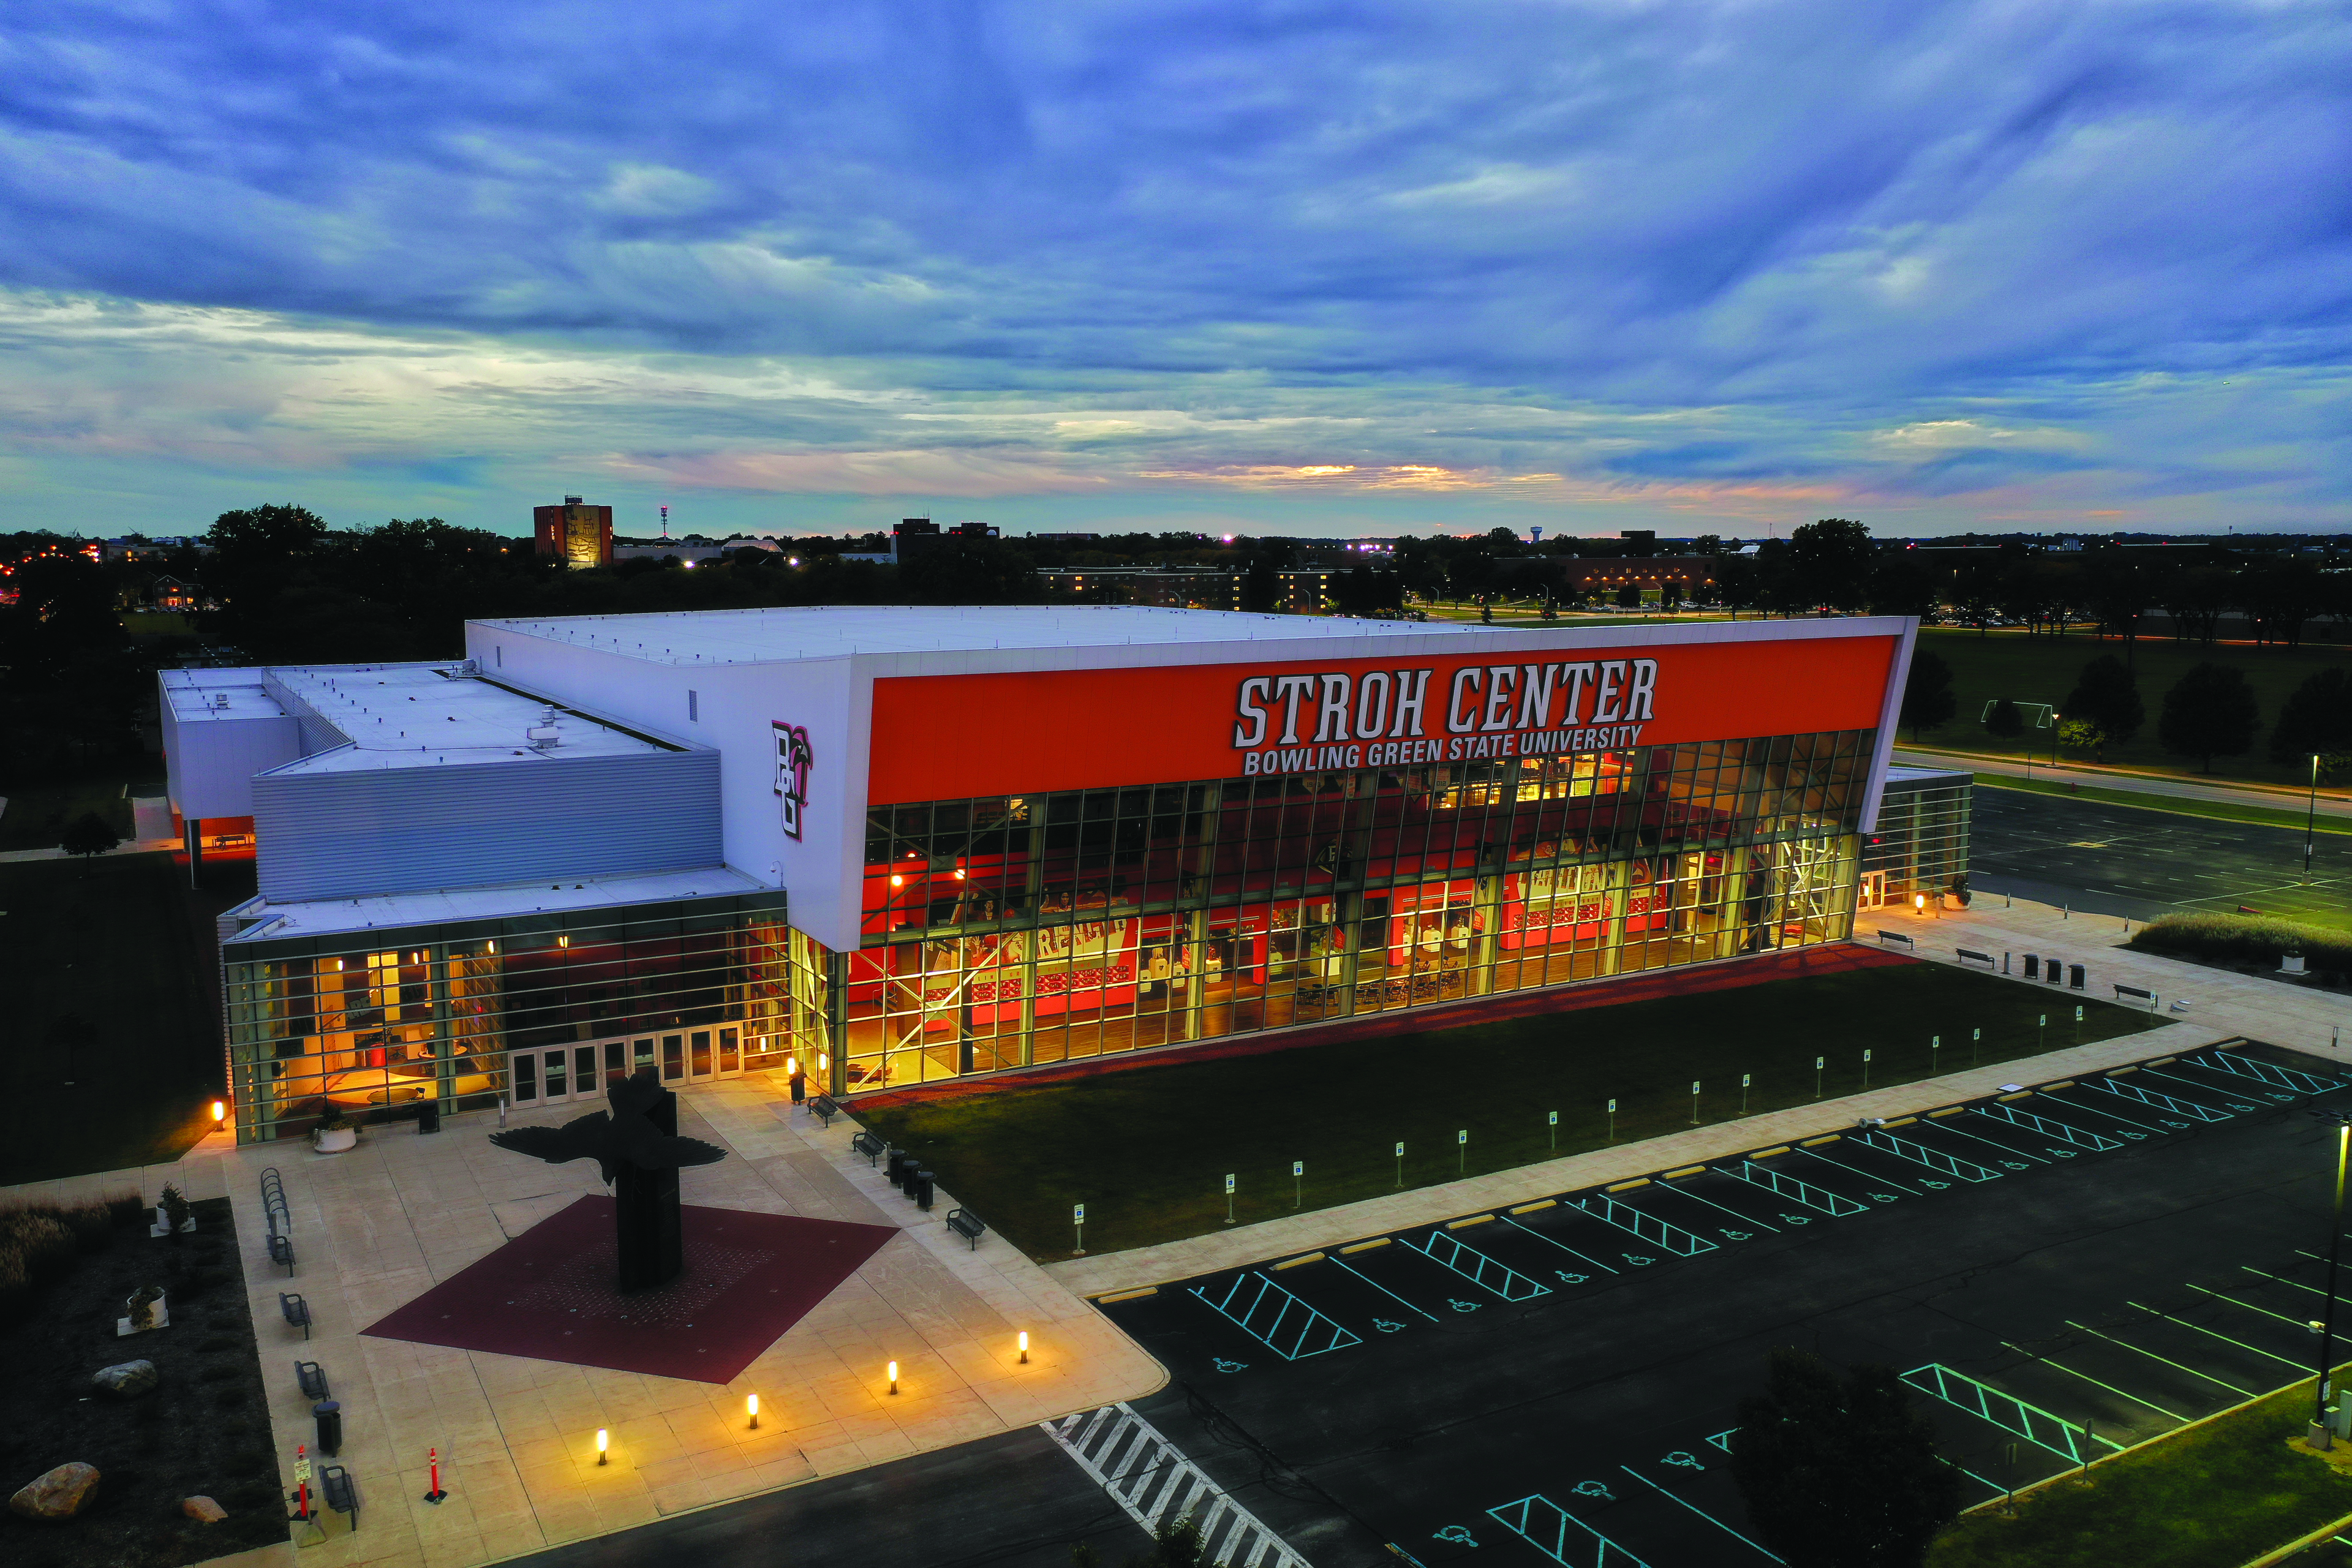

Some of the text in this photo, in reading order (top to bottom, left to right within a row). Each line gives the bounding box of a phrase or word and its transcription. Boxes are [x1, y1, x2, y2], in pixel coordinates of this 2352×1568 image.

[1235, 658, 1658, 748] STROH CENTER
[1244, 725, 1643, 775] BOWLING GREEN STATE UNIVERSITY
